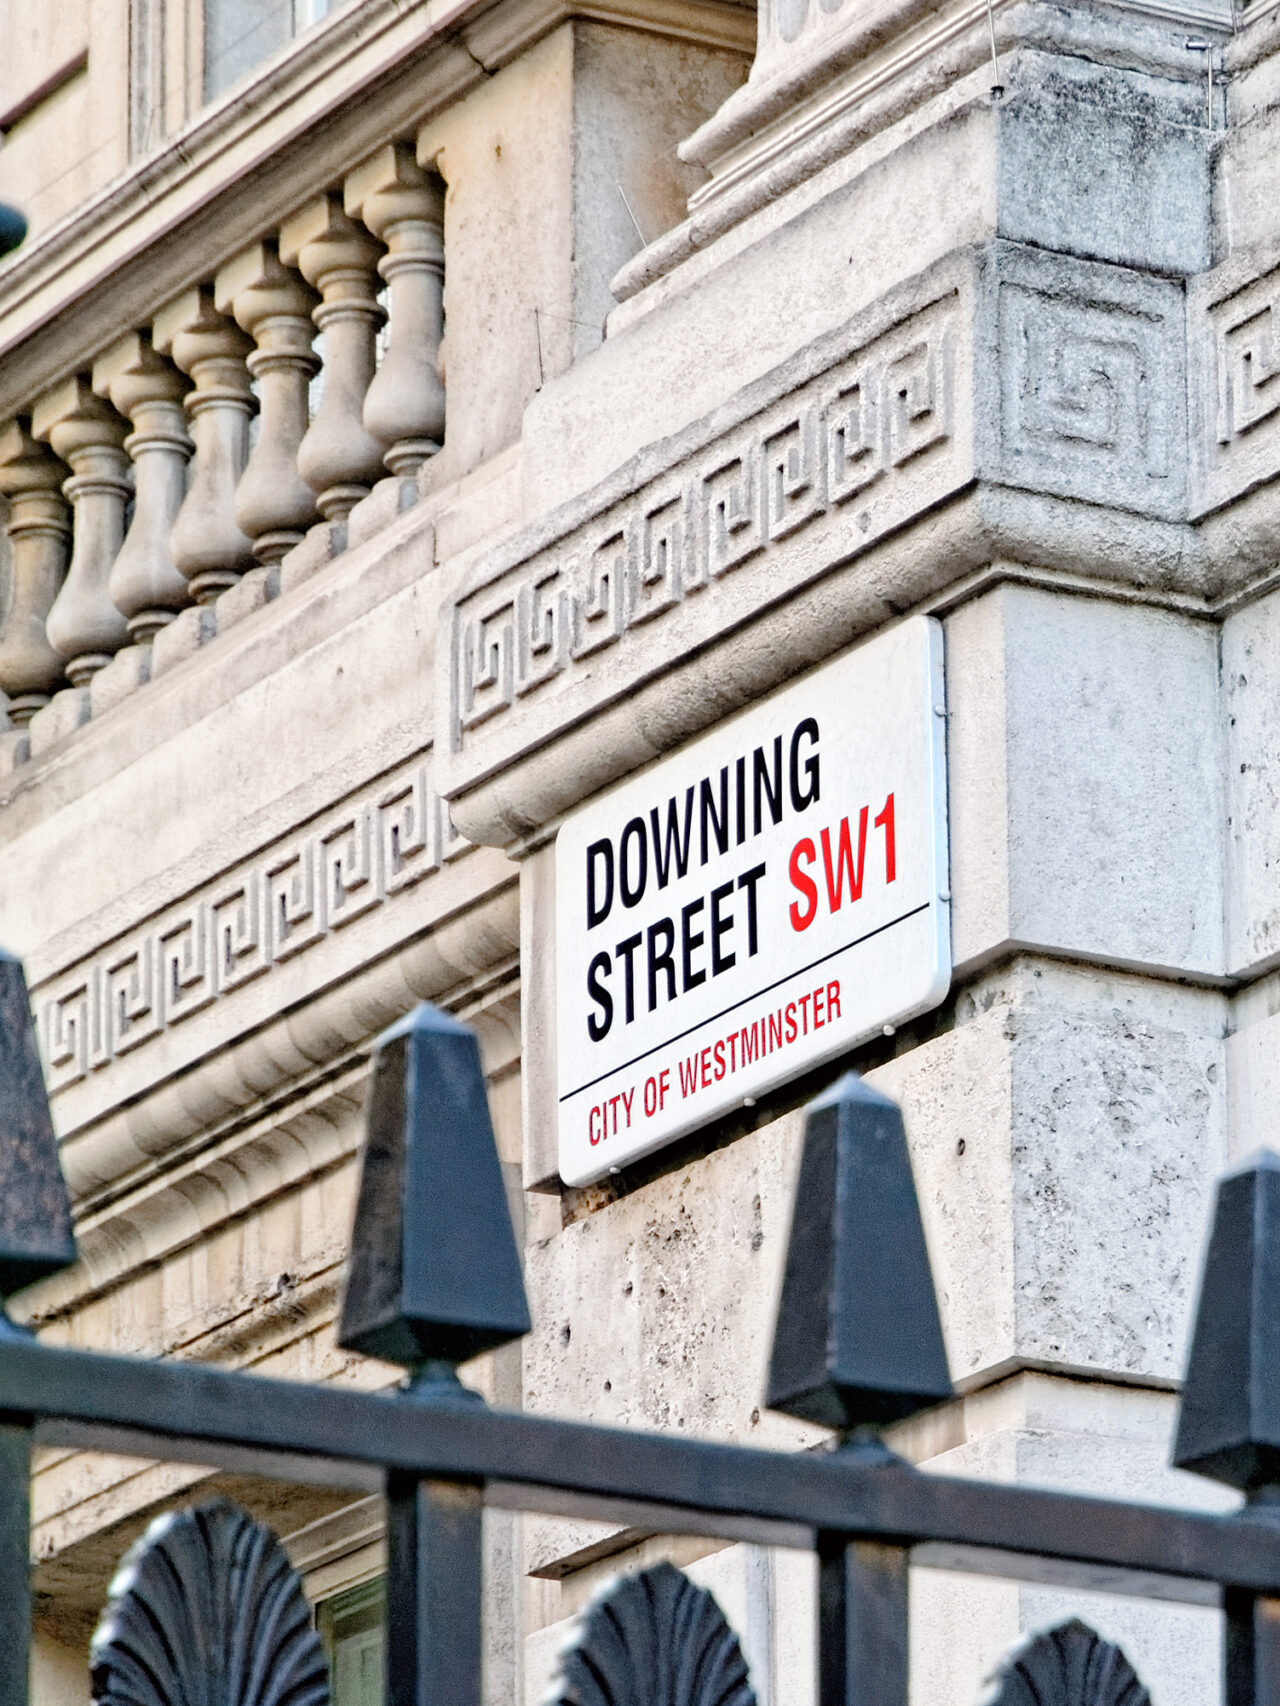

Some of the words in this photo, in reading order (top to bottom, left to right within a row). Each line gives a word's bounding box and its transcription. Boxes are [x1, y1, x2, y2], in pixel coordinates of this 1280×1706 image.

[587, 717, 820, 931] DOWNING
[587, 862, 766, 1043] STREET
[788, 792, 896, 932] SW1
[588, 1086, 635, 1147] CITY
[644, 1069, 671, 1112] OF
[679, 979, 842, 1099] WESTMINSTER
